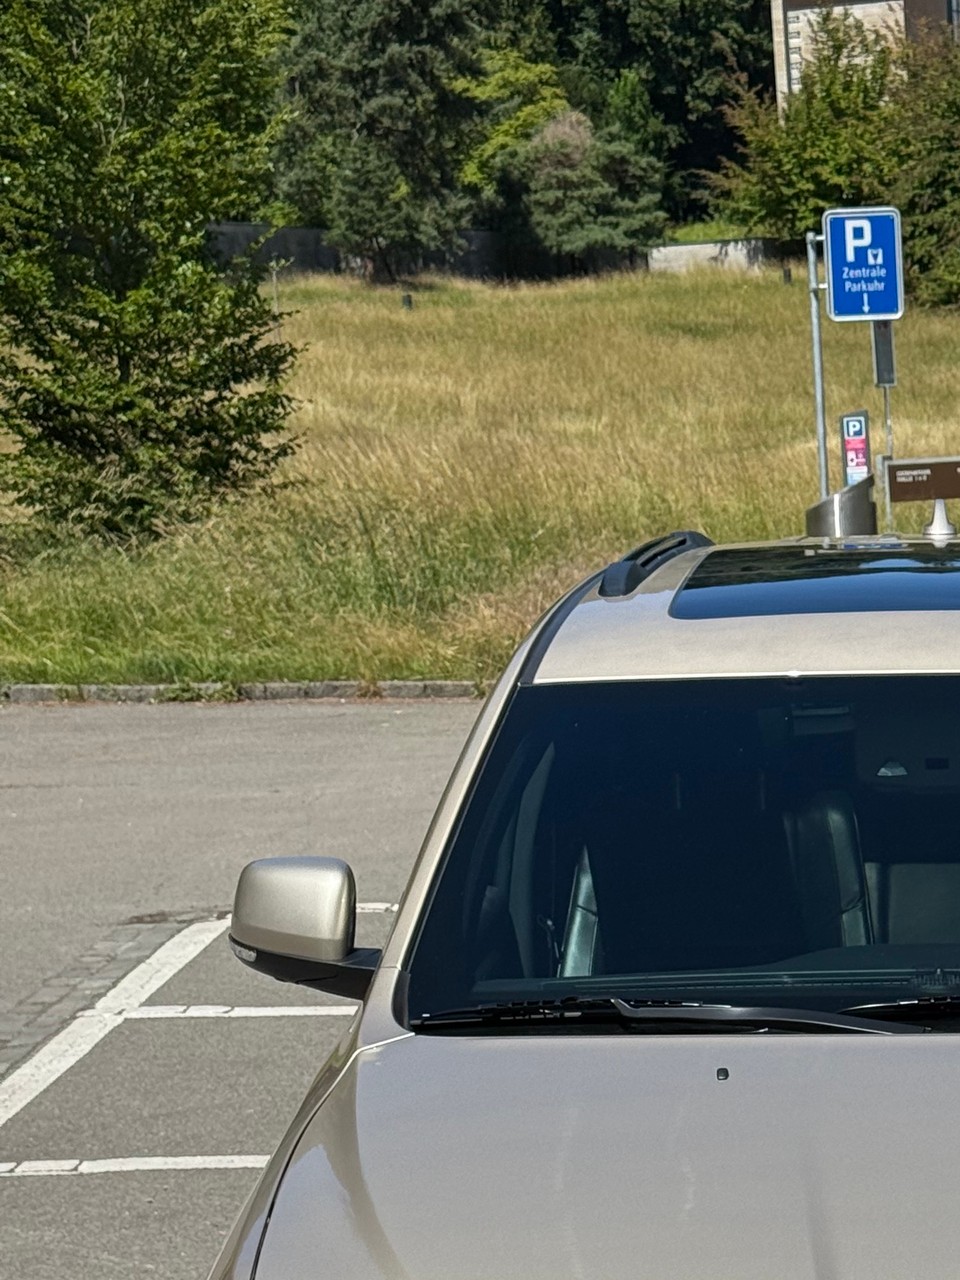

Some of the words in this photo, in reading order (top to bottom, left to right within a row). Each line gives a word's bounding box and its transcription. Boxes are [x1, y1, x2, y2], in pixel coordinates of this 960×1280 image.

[844, 219, 872, 263] P
[842, 266, 887, 279] Zentrale
[845, 279, 885, 292] Parkuhr
[849, 421, 861, 436] P
